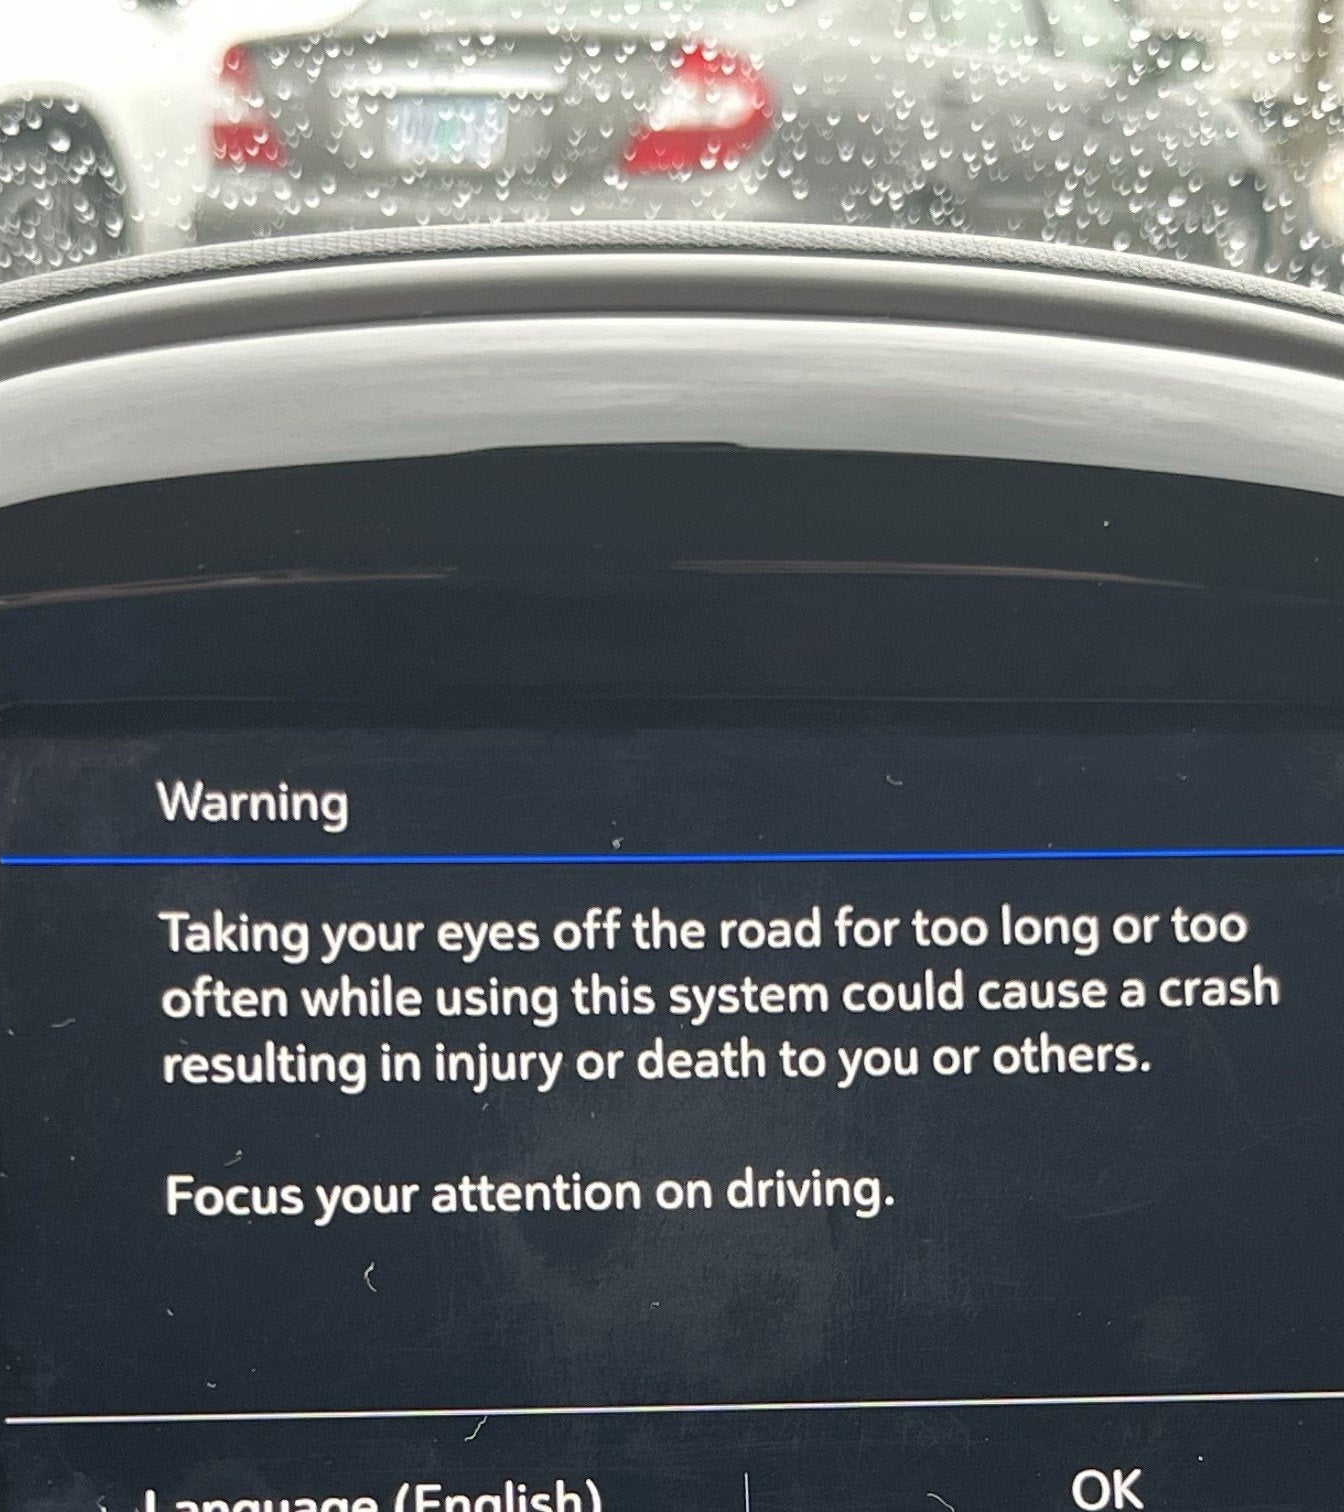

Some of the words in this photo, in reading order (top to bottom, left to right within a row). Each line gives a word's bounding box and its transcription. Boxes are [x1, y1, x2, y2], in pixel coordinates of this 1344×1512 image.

[154, 778, 350, 835] Warning
[155, 907, 311, 964] Taking
[319, 920, 426, 964] your
[435, 918, 542, 964] eyes
[551, 905, 624, 952] off
[630, 905, 708, 951] the
[718, 903, 823, 951] road
[832, 903, 903, 949] for
[909, 907, 990, 948] too
[1000, 901, 1101, 958] long
[1111, 912, 1162, 946] or
[1169, 904, 1250, 945] too
[160, 972, 290, 1020] often
[299, 971, 424, 1019] while
[434, 975, 560, 1029] using
[569, 970, 657, 1017] this
[668, 974, 831, 1028] system
[841, 966, 966, 1014] could
[977, 977, 1110, 1012] cause
[1118, 976, 1148, 1010] a
[1158, 962, 1282, 1009] crash
[161, 1038, 368, 1096] resulting
[379, 1041, 422, 1083] in
[434, 1040, 565, 1095] injury
[574, 1048, 626, 1082] or
[635, 1034, 768, 1081] death
[777, 1039, 828, 1079] to
[836, 1045, 920, 1090] you
[931, 1043, 982, 1077] or
[991, 1029, 1152, 1076] others.
[164, 1172, 306, 1218] Focus
[313, 1182, 422, 1228] your
[430, 1170, 643, 1215] attention
[653, 1178, 714, 1212] on
[725, 1163, 896, 1220] driving.
[1070, 1467, 1146, 1512] OK
